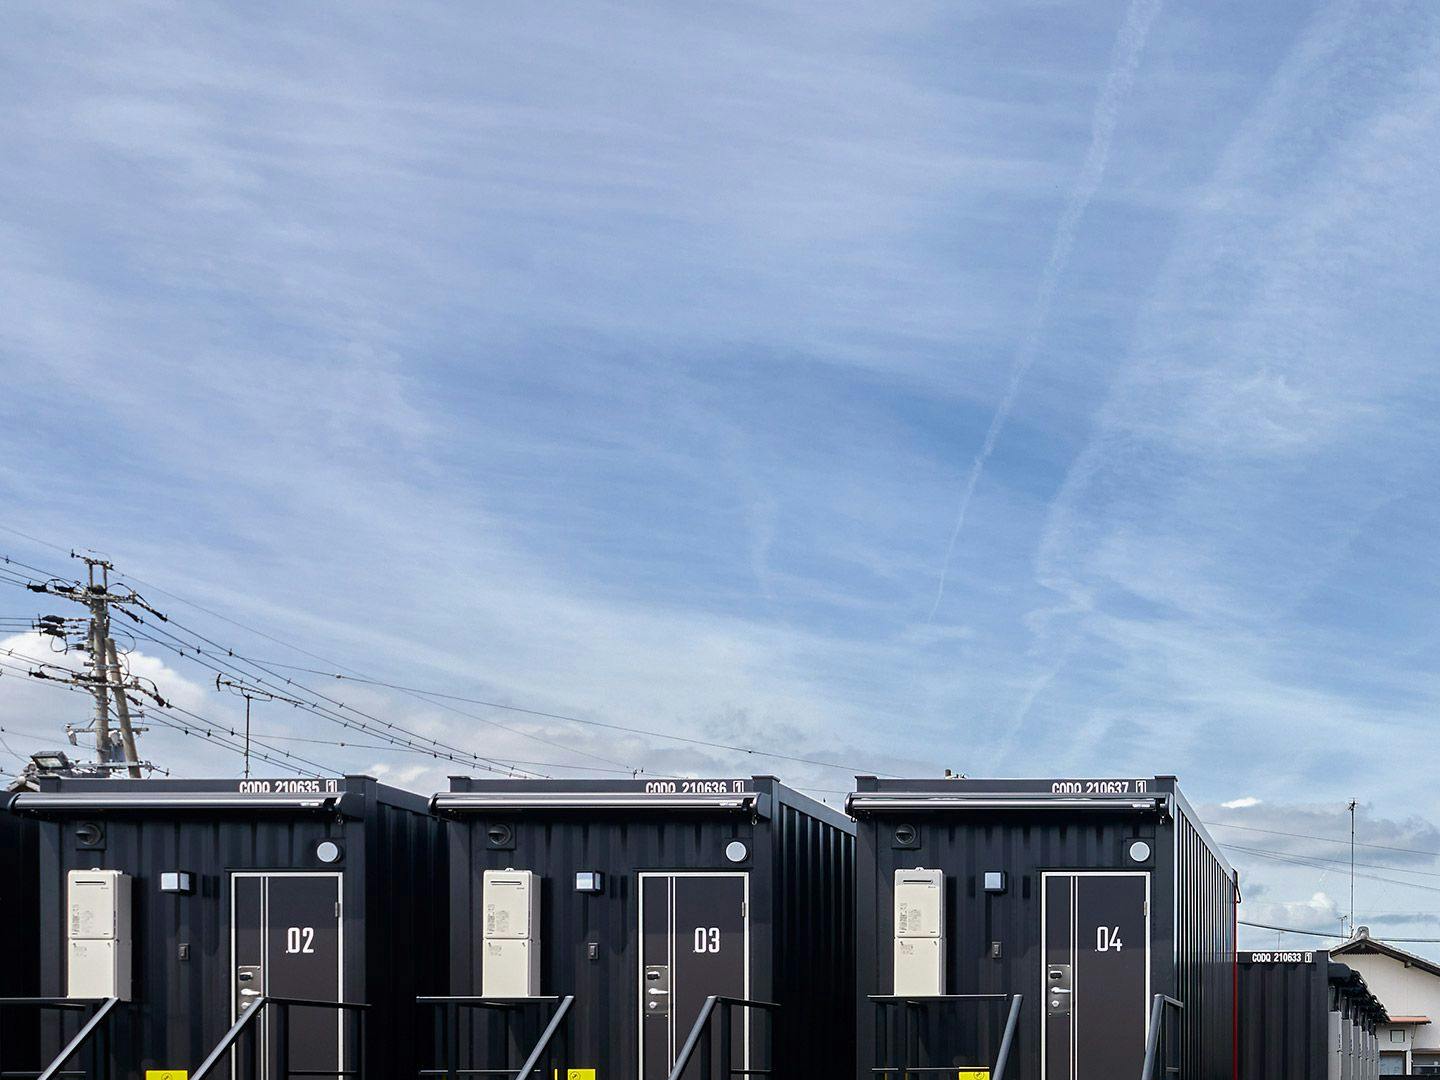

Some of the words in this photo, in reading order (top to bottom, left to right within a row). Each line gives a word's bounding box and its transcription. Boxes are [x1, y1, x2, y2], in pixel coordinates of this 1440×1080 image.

[274, 780, 320, 793] 210635
[682, 781, 727, 793] 210636
[1086, 781, 1129, 793] 210637
[287, 927, 314, 953] 02
[694, 927, 720, 953] 03
[1096, 926, 1123, 952] 04
[1273, 952, 1301, 963] 210633
